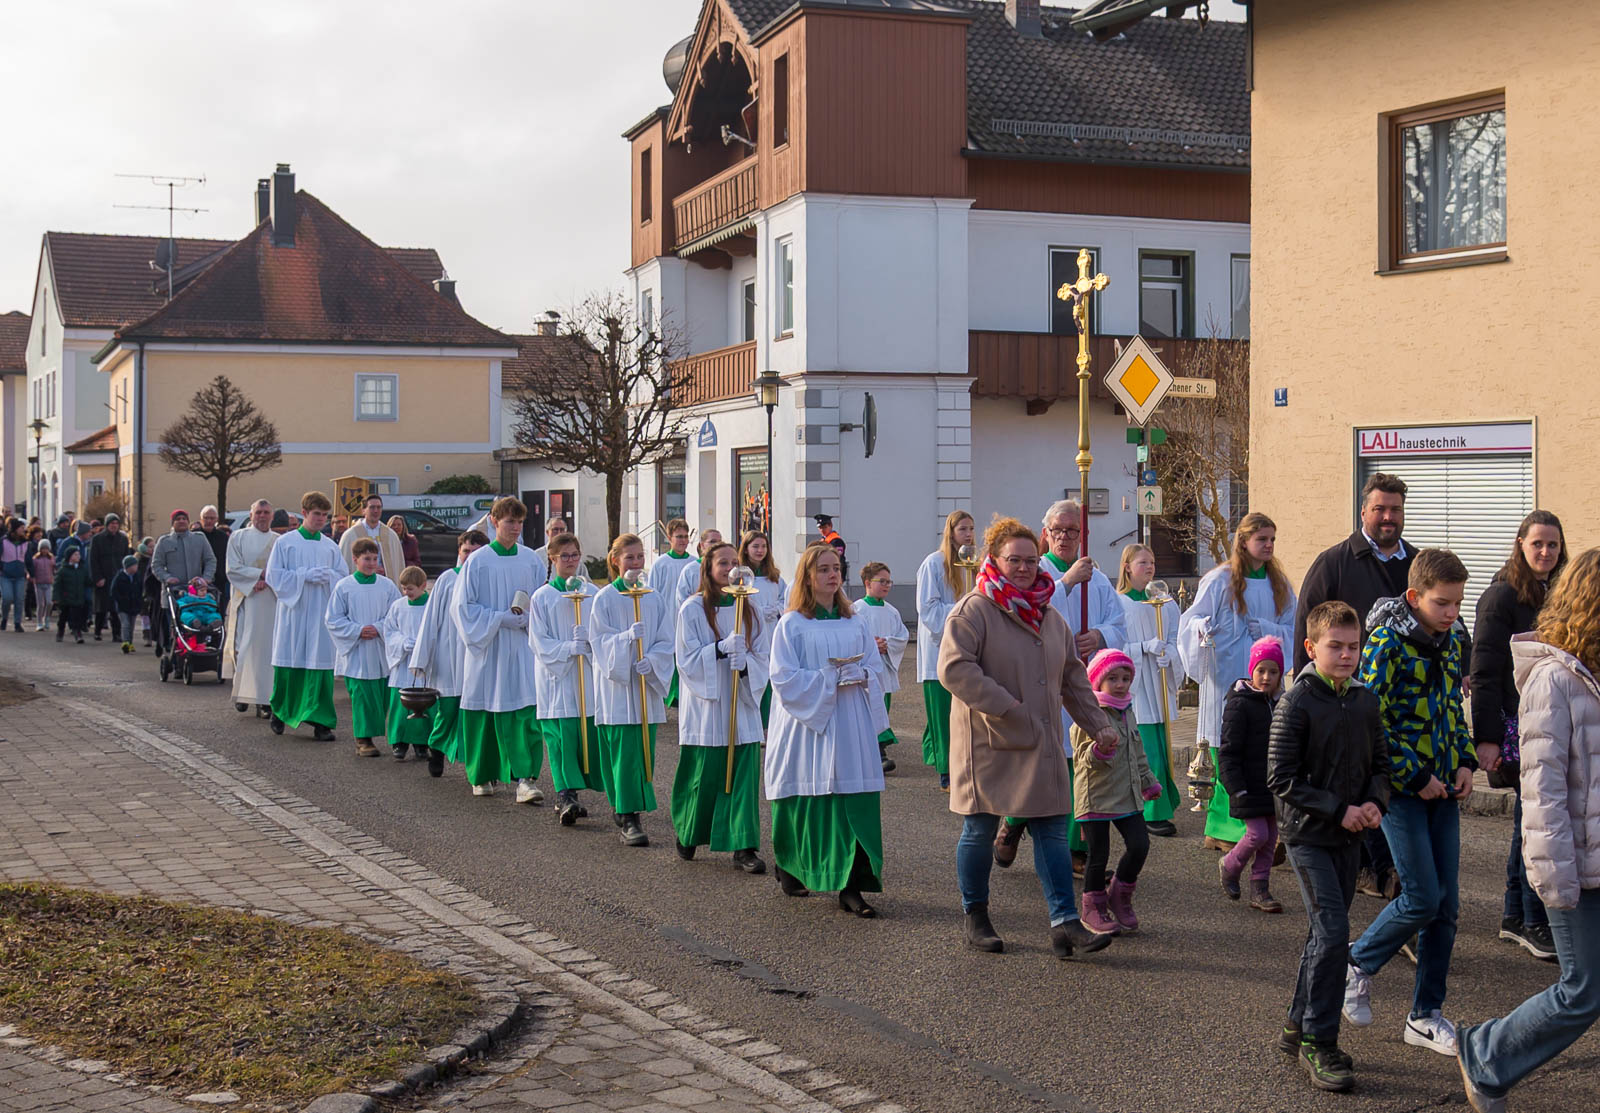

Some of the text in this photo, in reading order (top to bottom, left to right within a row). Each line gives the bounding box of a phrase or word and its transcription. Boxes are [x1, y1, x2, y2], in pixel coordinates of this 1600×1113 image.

[1196, 383, 1210, 394] Str.
[1361, 431, 1467, 450] LAU haustechnik
[415, 500, 431, 508] DER
